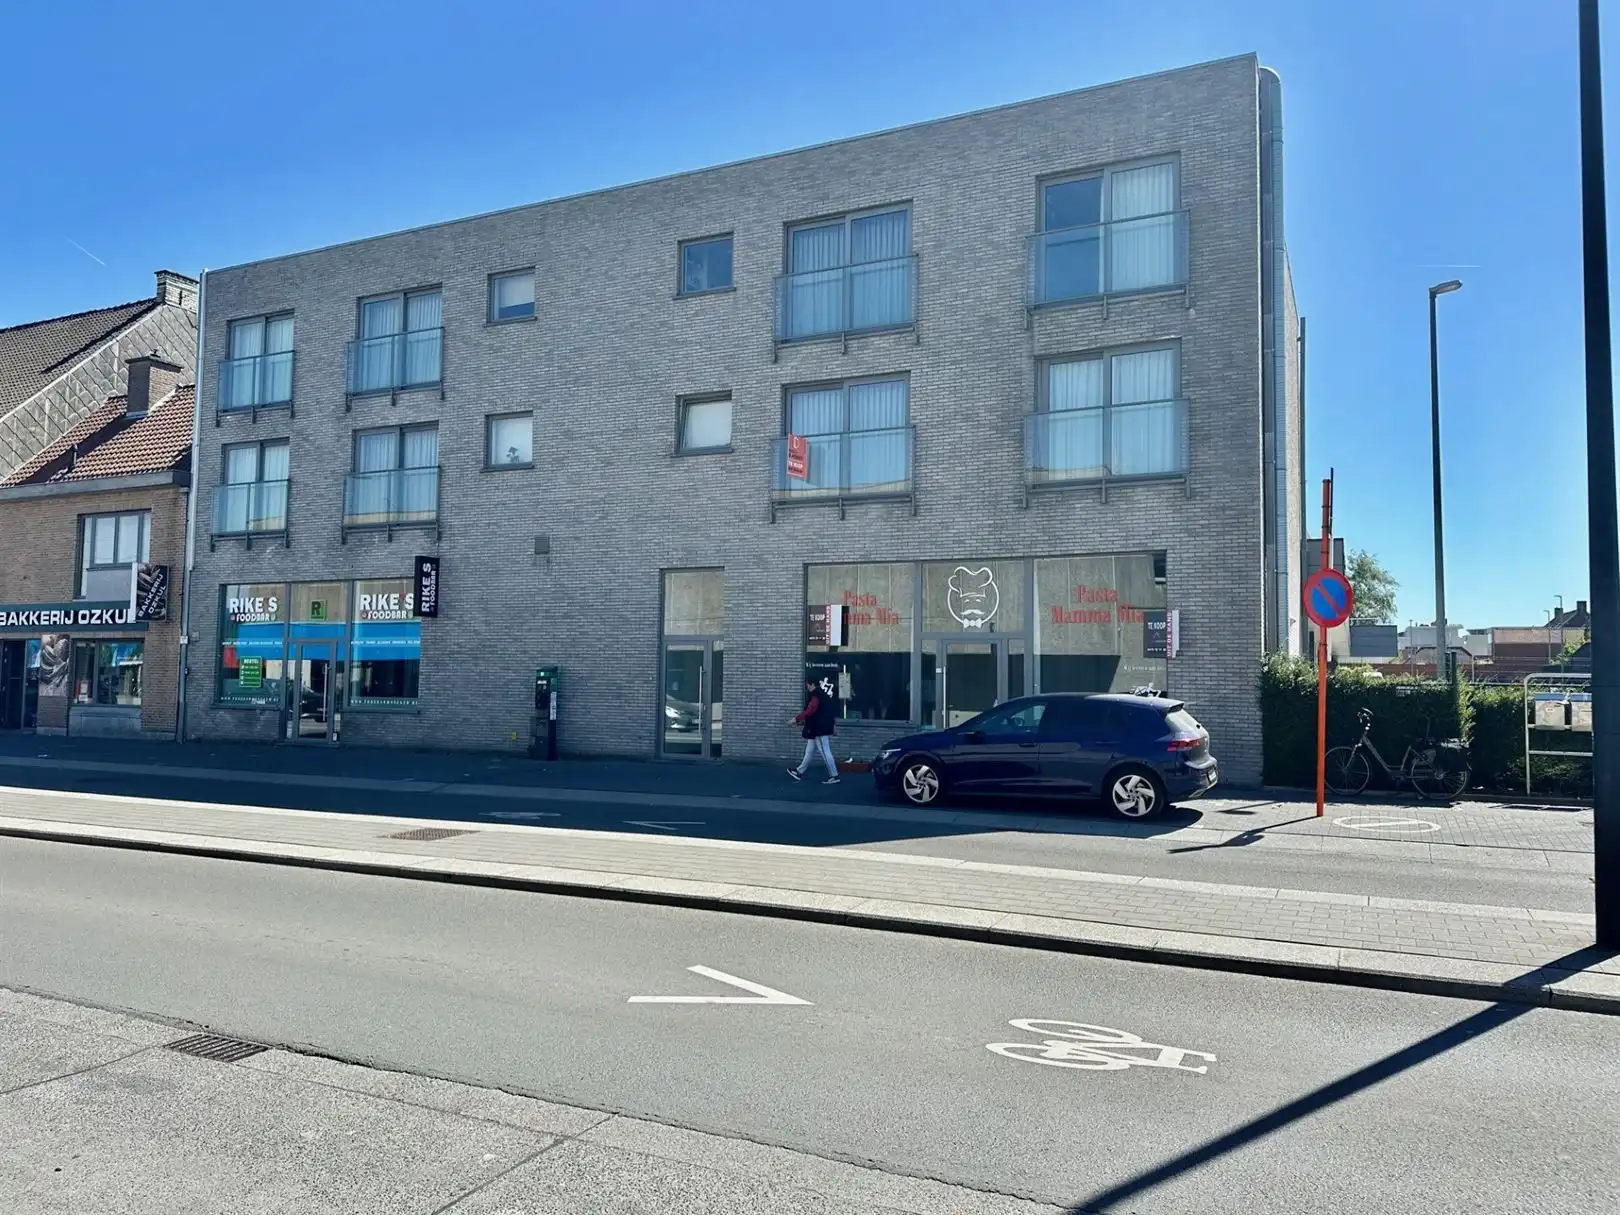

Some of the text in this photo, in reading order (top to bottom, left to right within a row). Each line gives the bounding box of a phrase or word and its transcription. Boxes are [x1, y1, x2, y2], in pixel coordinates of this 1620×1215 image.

[137, 574, 164, 617] BAKKERIJ
[148, 585, 167, 614] OZKUL
[360, 592, 414, 611] RIKE'S
[842, 590, 878, 607] Pasta
[1075, 584, 1117, 603] Pasta
[311, 600, 321, 616] R
[367, 610, 407, 620] FOODBAR
[1051, 603, 1144, 624] Mamma Mia
[0, 608, 136, 626] BAKKERIJ OZKUL
[236, 612, 270, 623] FOODBAR
[815, 613, 825, 621] KOOP
[1153, 621, 1166, 630] KOOP
[1166, 634, 1172, 643] DE
